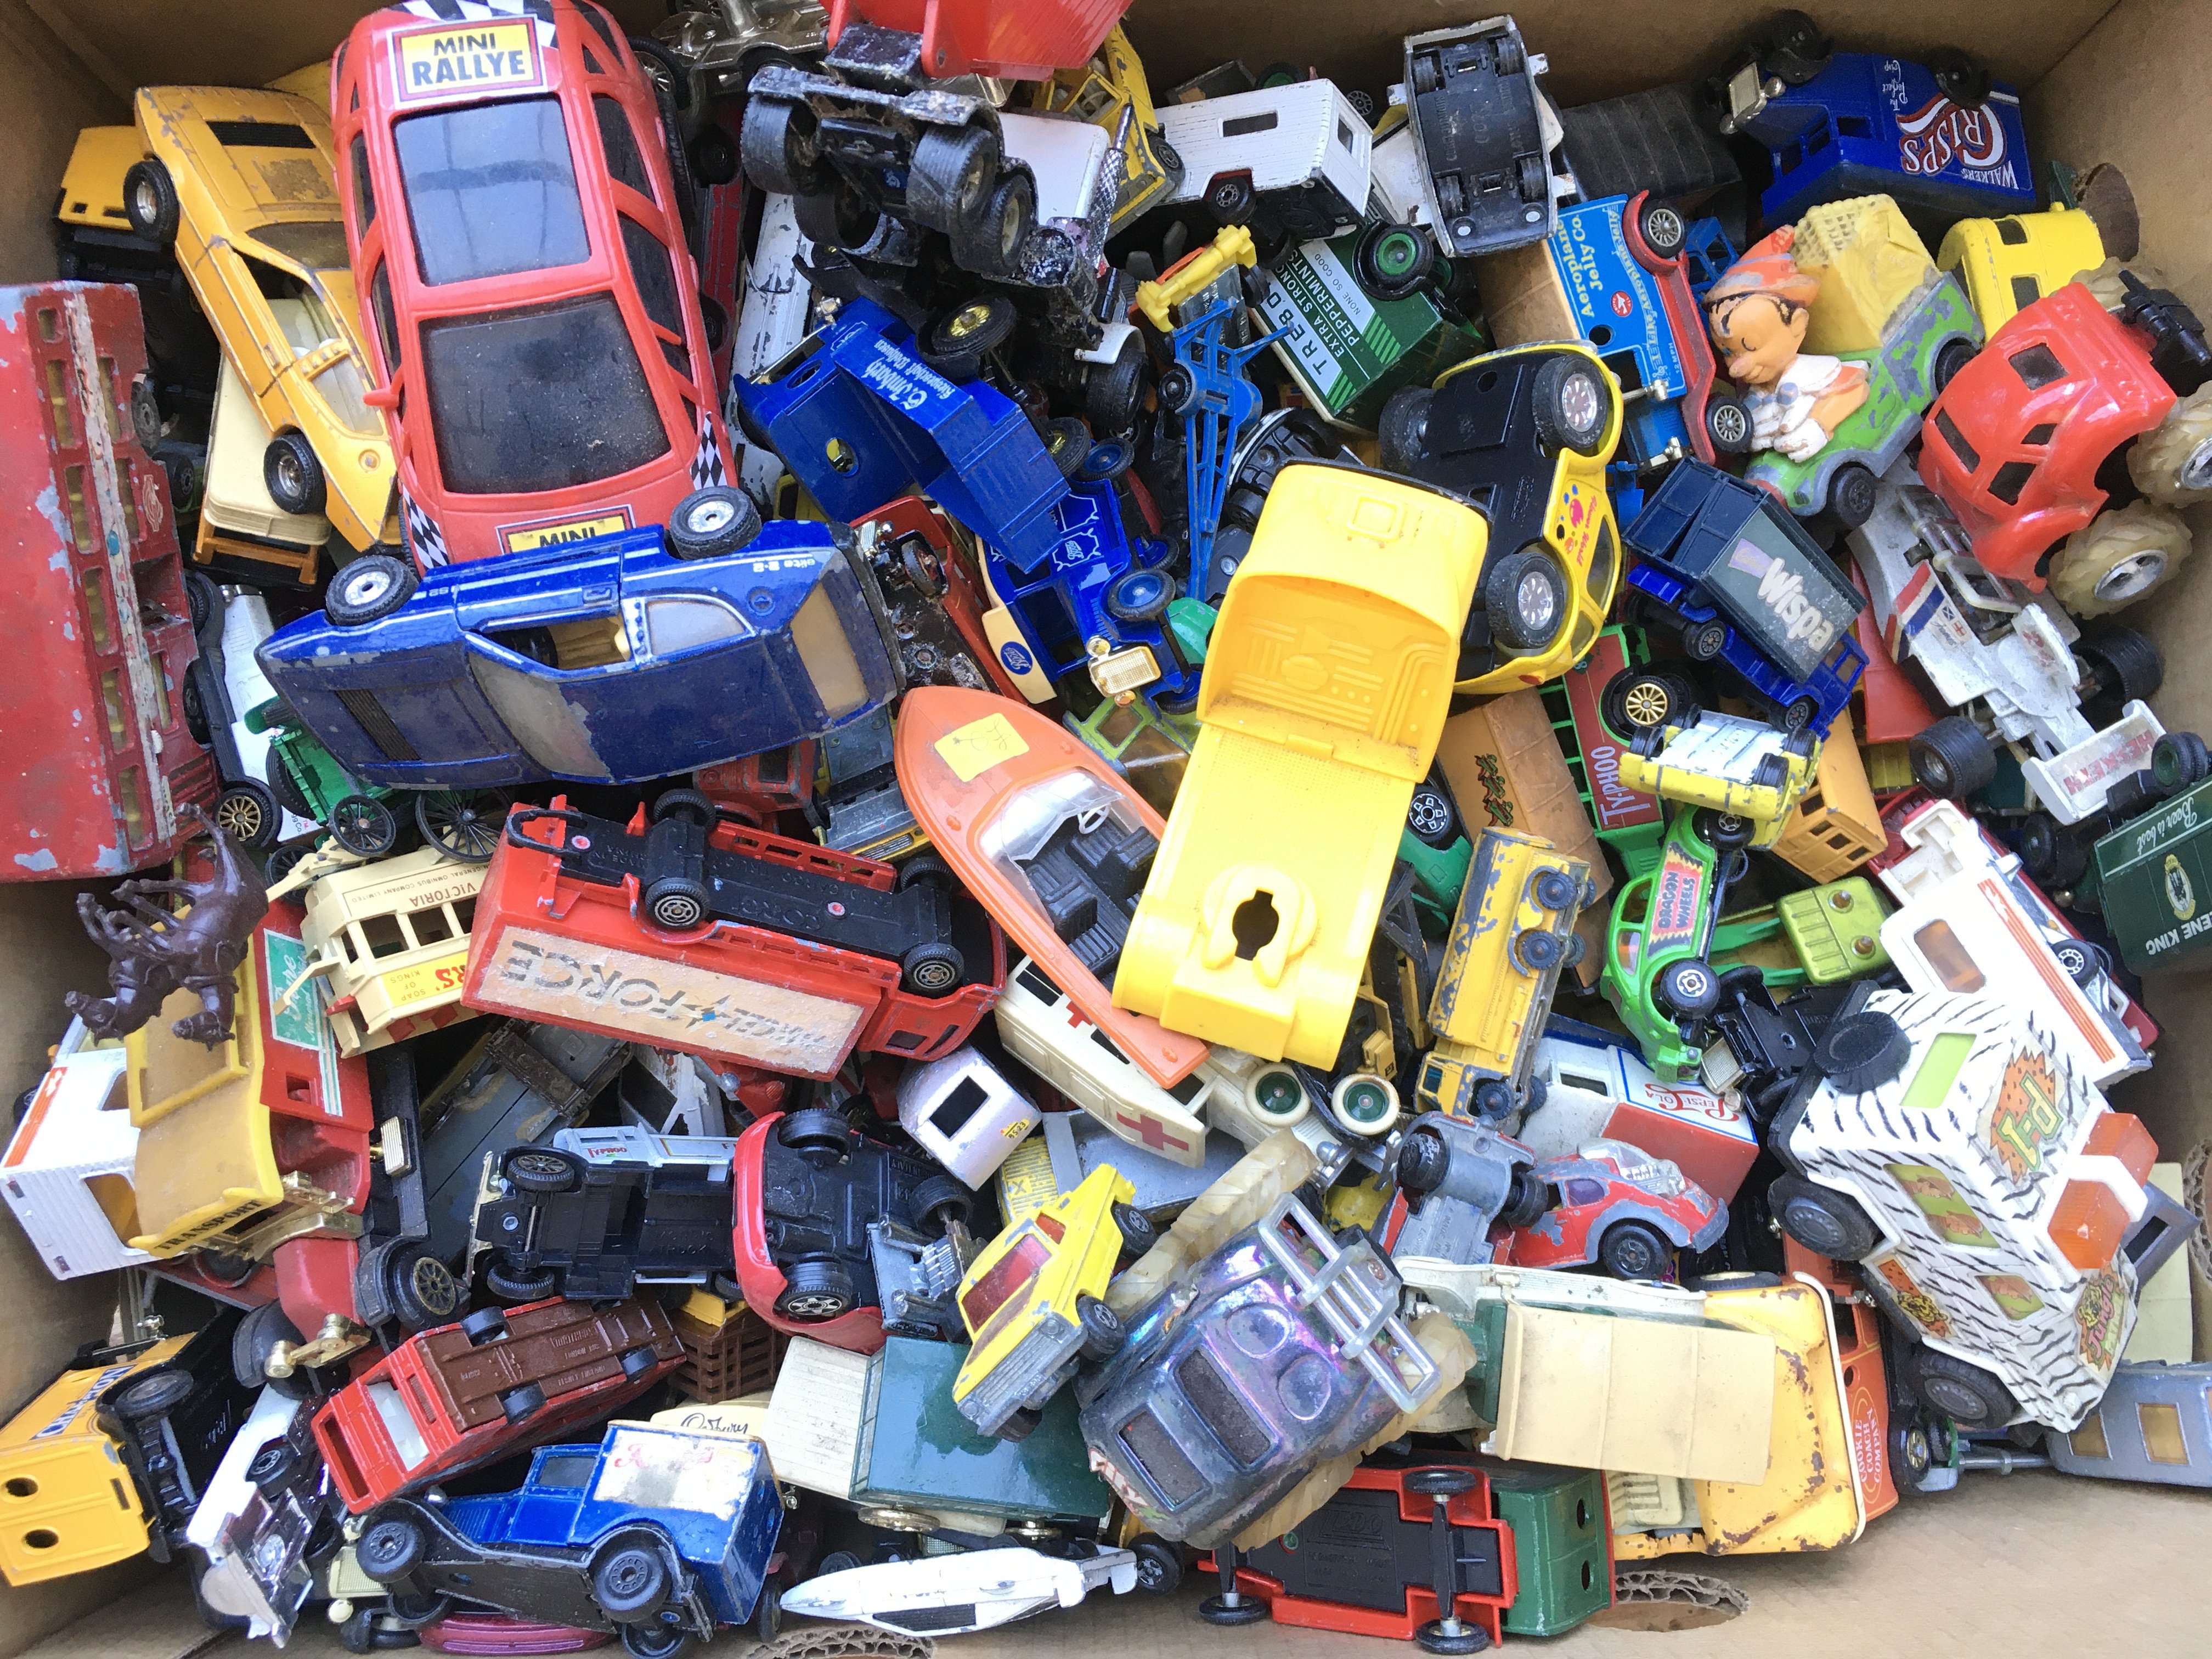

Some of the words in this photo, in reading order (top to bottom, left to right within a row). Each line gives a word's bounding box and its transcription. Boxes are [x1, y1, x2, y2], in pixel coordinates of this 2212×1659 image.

[434, 32, 496, 56] MINI
[412, 50, 525, 86] RALLYE
[1900, 101, 2004, 173] CRISPS
[1961, 160, 2019, 189] WALKERS
[1572, 215, 1585, 241] Co.
[1314, 253, 1333, 277] GOOD
[1556, 219, 1595, 319] Aeroplane
[1580, 243, 1603, 291] Jelly
[1289, 249, 1360, 347] PEPPERMINTS
[1333, 278, 1343, 291] SO
[1342, 292, 1361, 315] NONE
[1267, 282, 1327, 376] TREBO
[1313, 315, 1345, 358] EXTRA
[1669, 342, 1679, 362] MPH
[1675, 364, 1681, 375] 12
[538, 527, 595, 547] MINI
[1065, 540, 1085, 560] Boots
[1757, 558, 1834, 653] Wispa
[1003, 647, 1032, 670] Boots
[2167, 797, 2197, 828] Beer
[2137, 826, 2157, 855] best
[2157, 819, 2166, 837] is
[416, 874, 449, 887] OMNIBUS
[450, 866, 482, 878] GENERAL
[351, 890, 382, 903] LIMITED
[383, 882, 415, 896] COMPANY
[409, 882, 477, 907] VICTORIA
[1658, 871, 1679, 929] DRAGON
[1676, 877, 1696, 929] WHEELS
[2145, 928, 2180, 956] KING
[390, 969, 421, 984] KINGS
[404, 981, 416, 990] OF
[501, 940, 686, 1022] FORCE
[400, 989, 426, 1002] SOAP
[1686, 1097, 1740, 1121] PEPSI
[154, 1199, 262, 1250] TRANSPORT
[2087, 1277, 2115, 1359] Jungle
[35, 1364, 137, 1437] CHAMPION
[1855, 1419, 1867, 1483] COOKIE
[1863, 1423, 1874, 1473] COACH
[1866, 1407, 1881, 1483] COMPANY
[1088, 1446, 1151, 1506] City
